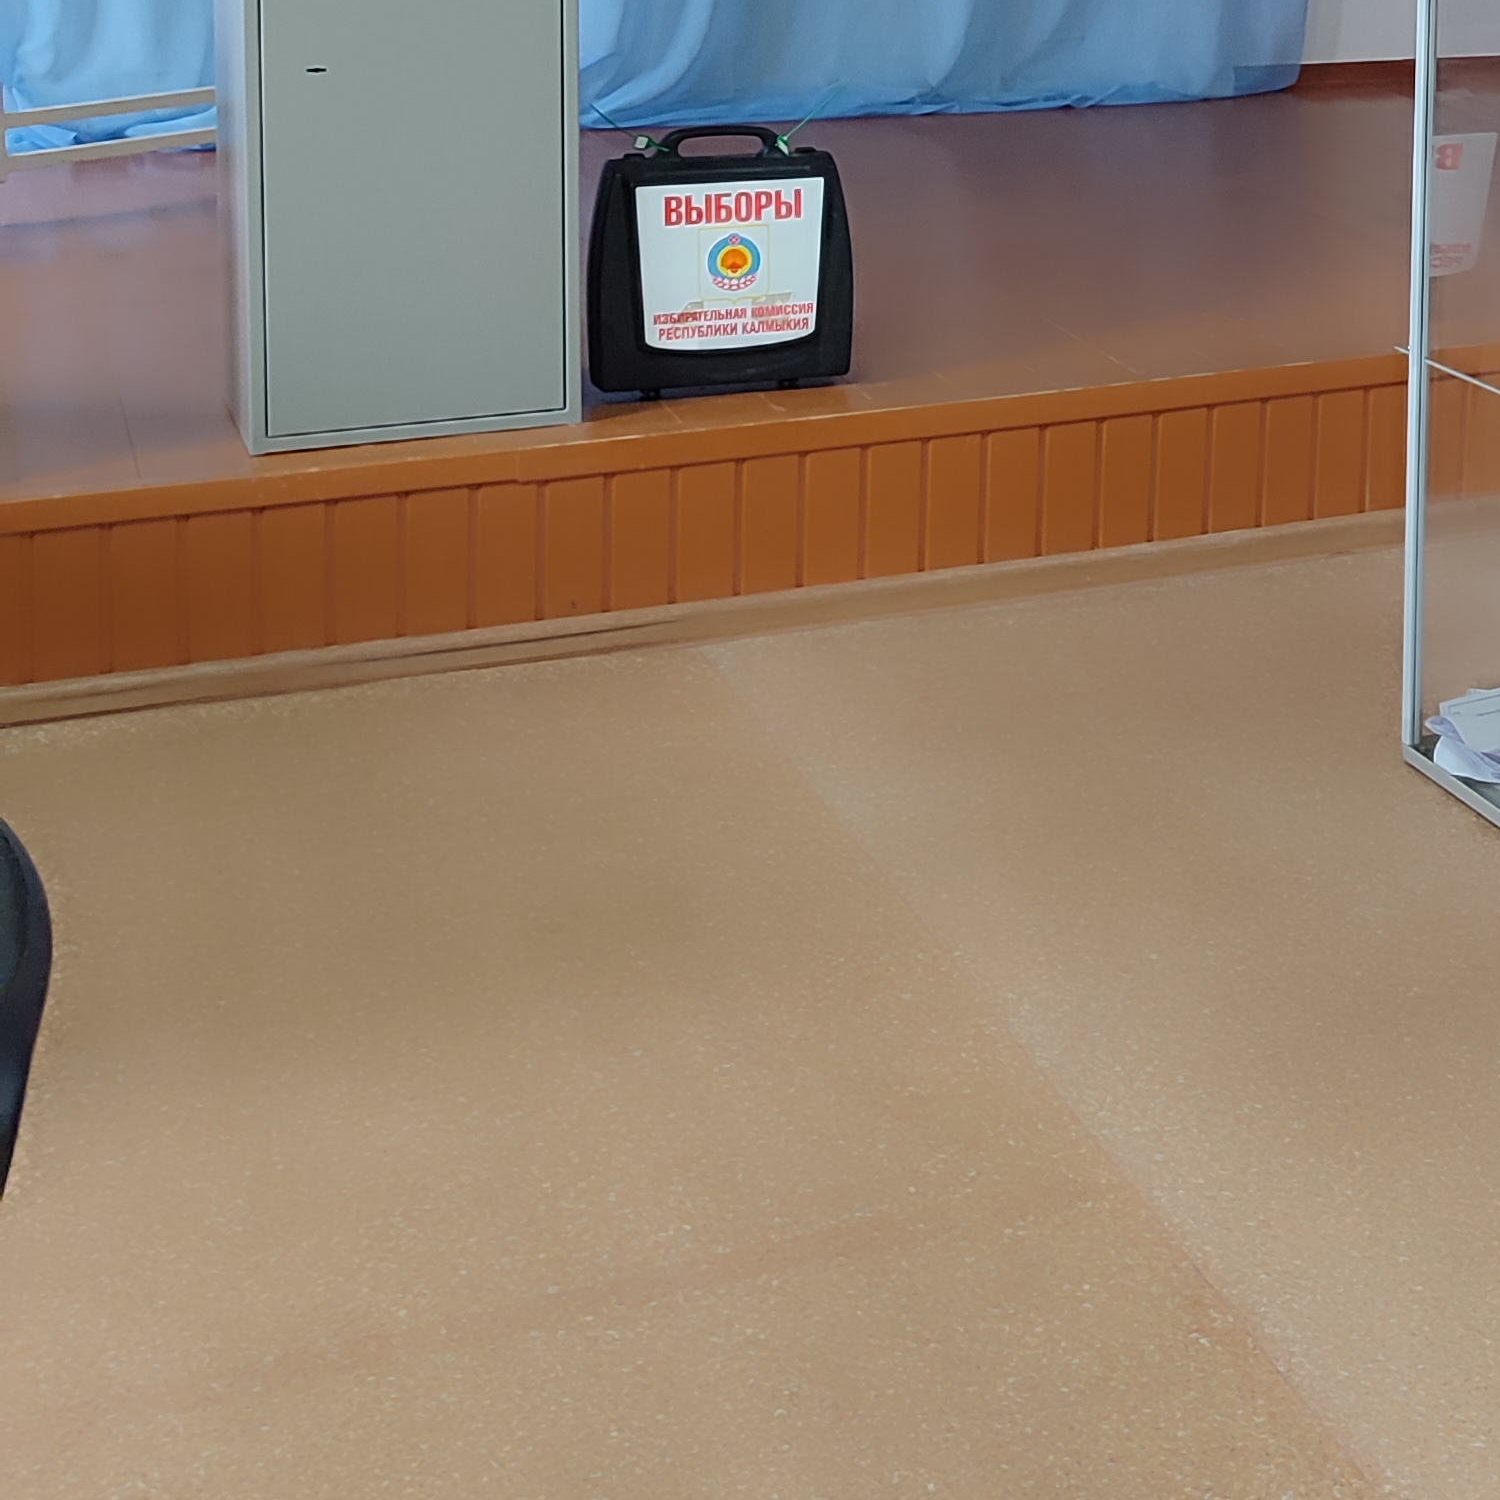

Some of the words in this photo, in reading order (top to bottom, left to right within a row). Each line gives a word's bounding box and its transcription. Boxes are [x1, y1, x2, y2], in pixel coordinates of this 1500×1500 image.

[663, 188, 803, 227] ВЫБОРЫ
[653, 307, 748, 326] ИЗБИРАТЕЛЬНАЯ
[751, 302, 814, 320] КОМИССИЯ
[658, 324, 738, 341] РЕСПУБЛИКИ
[741, 317, 809, 335] КАЛМЫКИЯ
